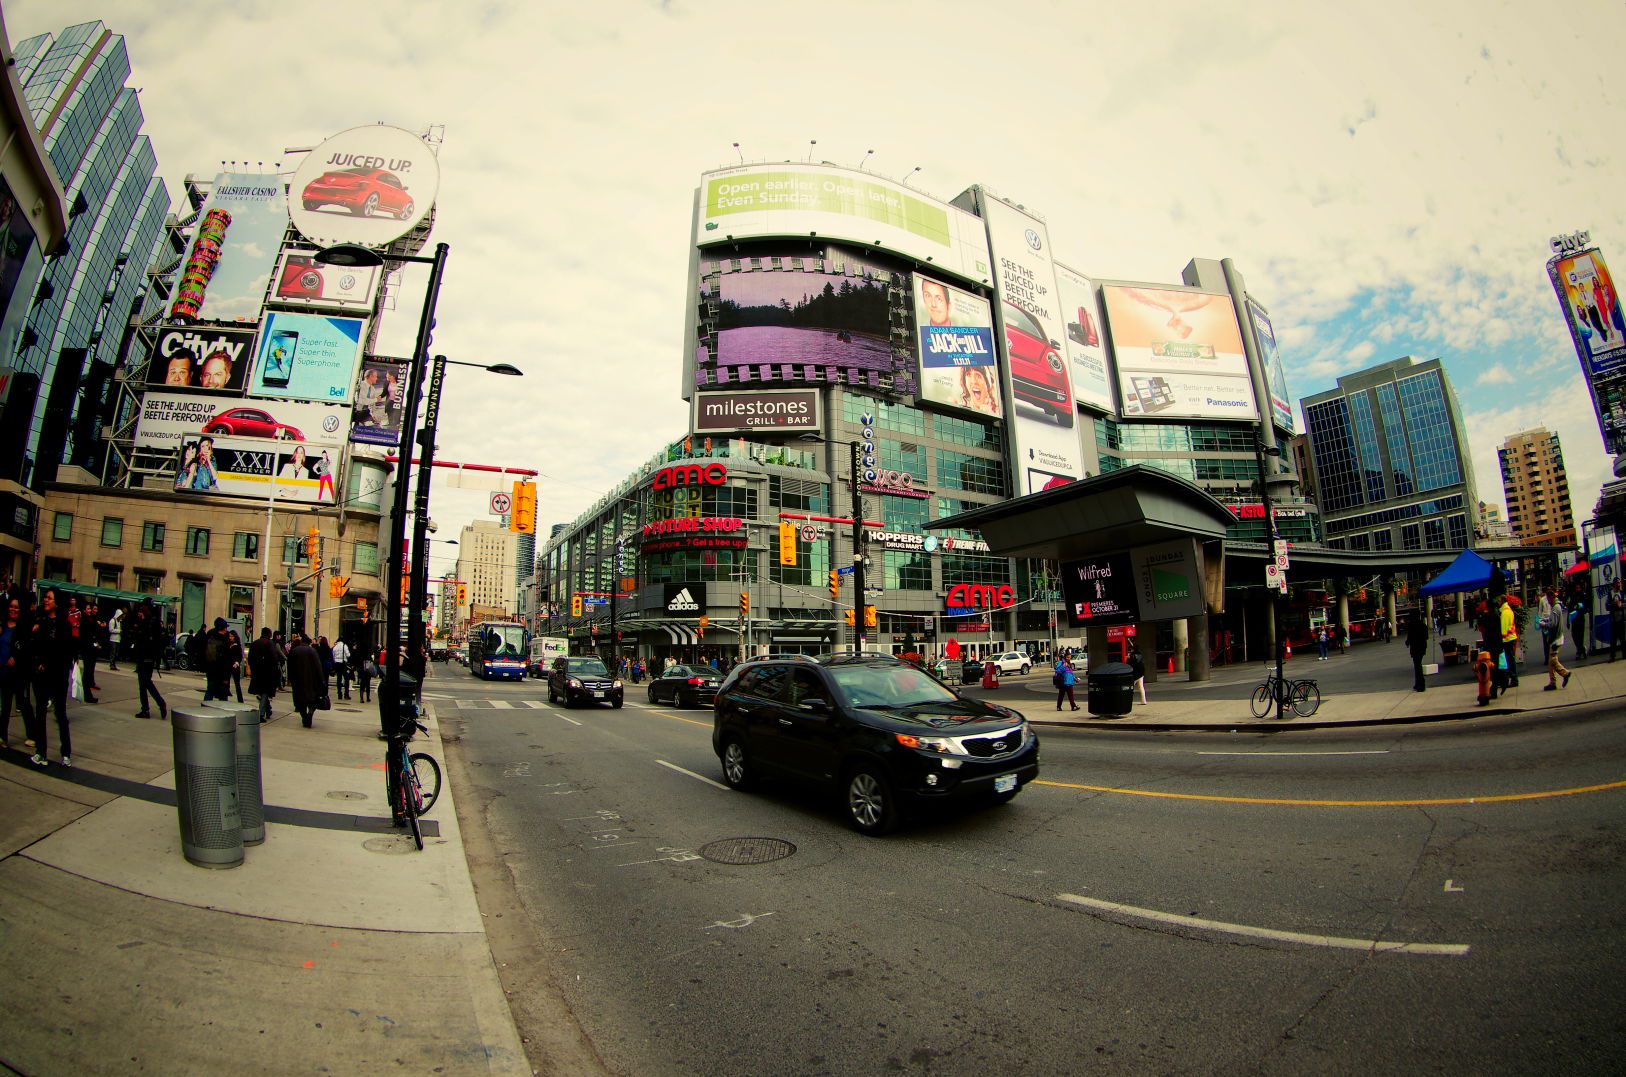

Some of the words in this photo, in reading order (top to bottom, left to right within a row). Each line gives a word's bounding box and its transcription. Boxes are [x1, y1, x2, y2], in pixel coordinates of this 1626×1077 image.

[327, 152, 385, 169] JUICED
[388, 157, 412, 173] UP.
[217, 185, 251, 196] FALLSVIEW
[251, 186, 277, 197] CASINO
[718, 182, 759, 196] Open
[764, 178, 818, 193] earlier.
[823, 181, 864, 197] Open
[868, 188, 901, 209] later.
[717, 197, 754, 209] Even
[759, 191, 818, 207] Sunday.
[1549, 229, 1592, 253] Citytv
[1001, 257, 1017, 272] SEE
[1017, 265, 1034, 280] THE
[1003, 270, 1034, 290] JUICED
[1035, 284, 1047, 296] UP
[1004, 281, 1035, 302] BEETLE
[1006, 293, 1052, 320] PERFORM.
[161, 331, 245, 366] Citytv
[301, 337, 323, 346] Super
[929, 333, 961, 353] JACK
[963, 335, 989, 354] JILL
[299, 348, 321, 357] Super
[297, 358, 341, 368] Superphone.
[329, 386, 345, 397] Bell
[392, 363, 407, 410] BUSINESS
[427, 361, 443, 427] DOWNTOWN
[146, 400, 160, 410] SEE
[160, 401, 174, 411] THE
[174, 401, 203, 413] JUICED
[203, 404, 216, 414] UP
[706, 399, 808, 416] milestones
[1206, 397, 1248, 408] Panasonic
[144, 410, 171, 421] BEETLE
[746, 417, 776, 425] GRILL
[787, 417, 810, 425] BAR
[140, 431, 182, 440] VWJUICEDUP.CA
[232, 451, 273, 470] XXI
[230, 466, 271, 474] FOREVER
[655, 504, 701, 519] OURT
[652, 518, 700, 536] FUTURE
[702, 517, 743, 532] SHOP
[692, 538, 706, 546] Get
[715, 538, 730, 546] free
[868, 530, 923, 544] HOPPERS
[942, 535, 977, 551] EXTREME
[886, 541, 905, 549] DRUG
[1077, 562, 1112, 580] Wilfred
[1158, 590, 1188, 601] SQUARE
[668, 602, 699, 611] adidas
[947, 607, 975, 616] IMAX
[1075, 602, 1092, 615] FX
[1092, 605, 1113, 613] OCTOBER
[544, 643, 567, 651] FedEx
